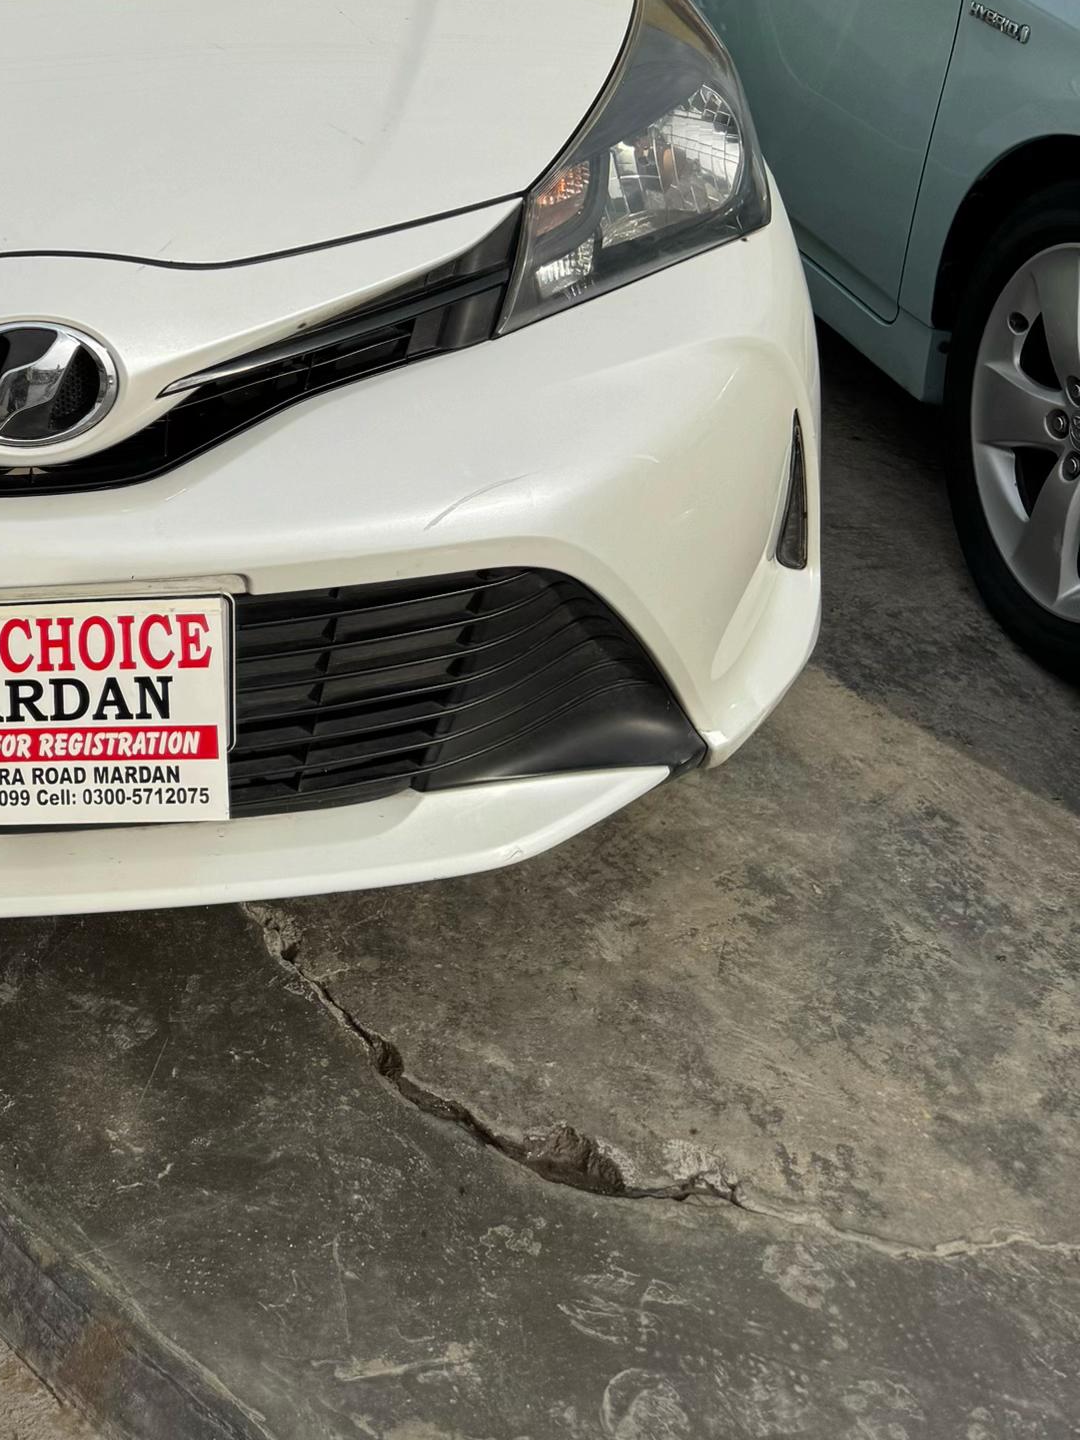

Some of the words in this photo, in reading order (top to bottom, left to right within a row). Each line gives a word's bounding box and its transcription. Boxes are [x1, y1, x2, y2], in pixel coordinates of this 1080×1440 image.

[969, 0, 1020, 38] HYBRID
[38, 731, 201, 759] REGISTRATION
[31, 766, 87, 785] ROAD
[93, 765, 180, 785] MARDAN
[36, 789, 77, 807] Cell:
[82, 788, 210, 806] 0300-5712075
